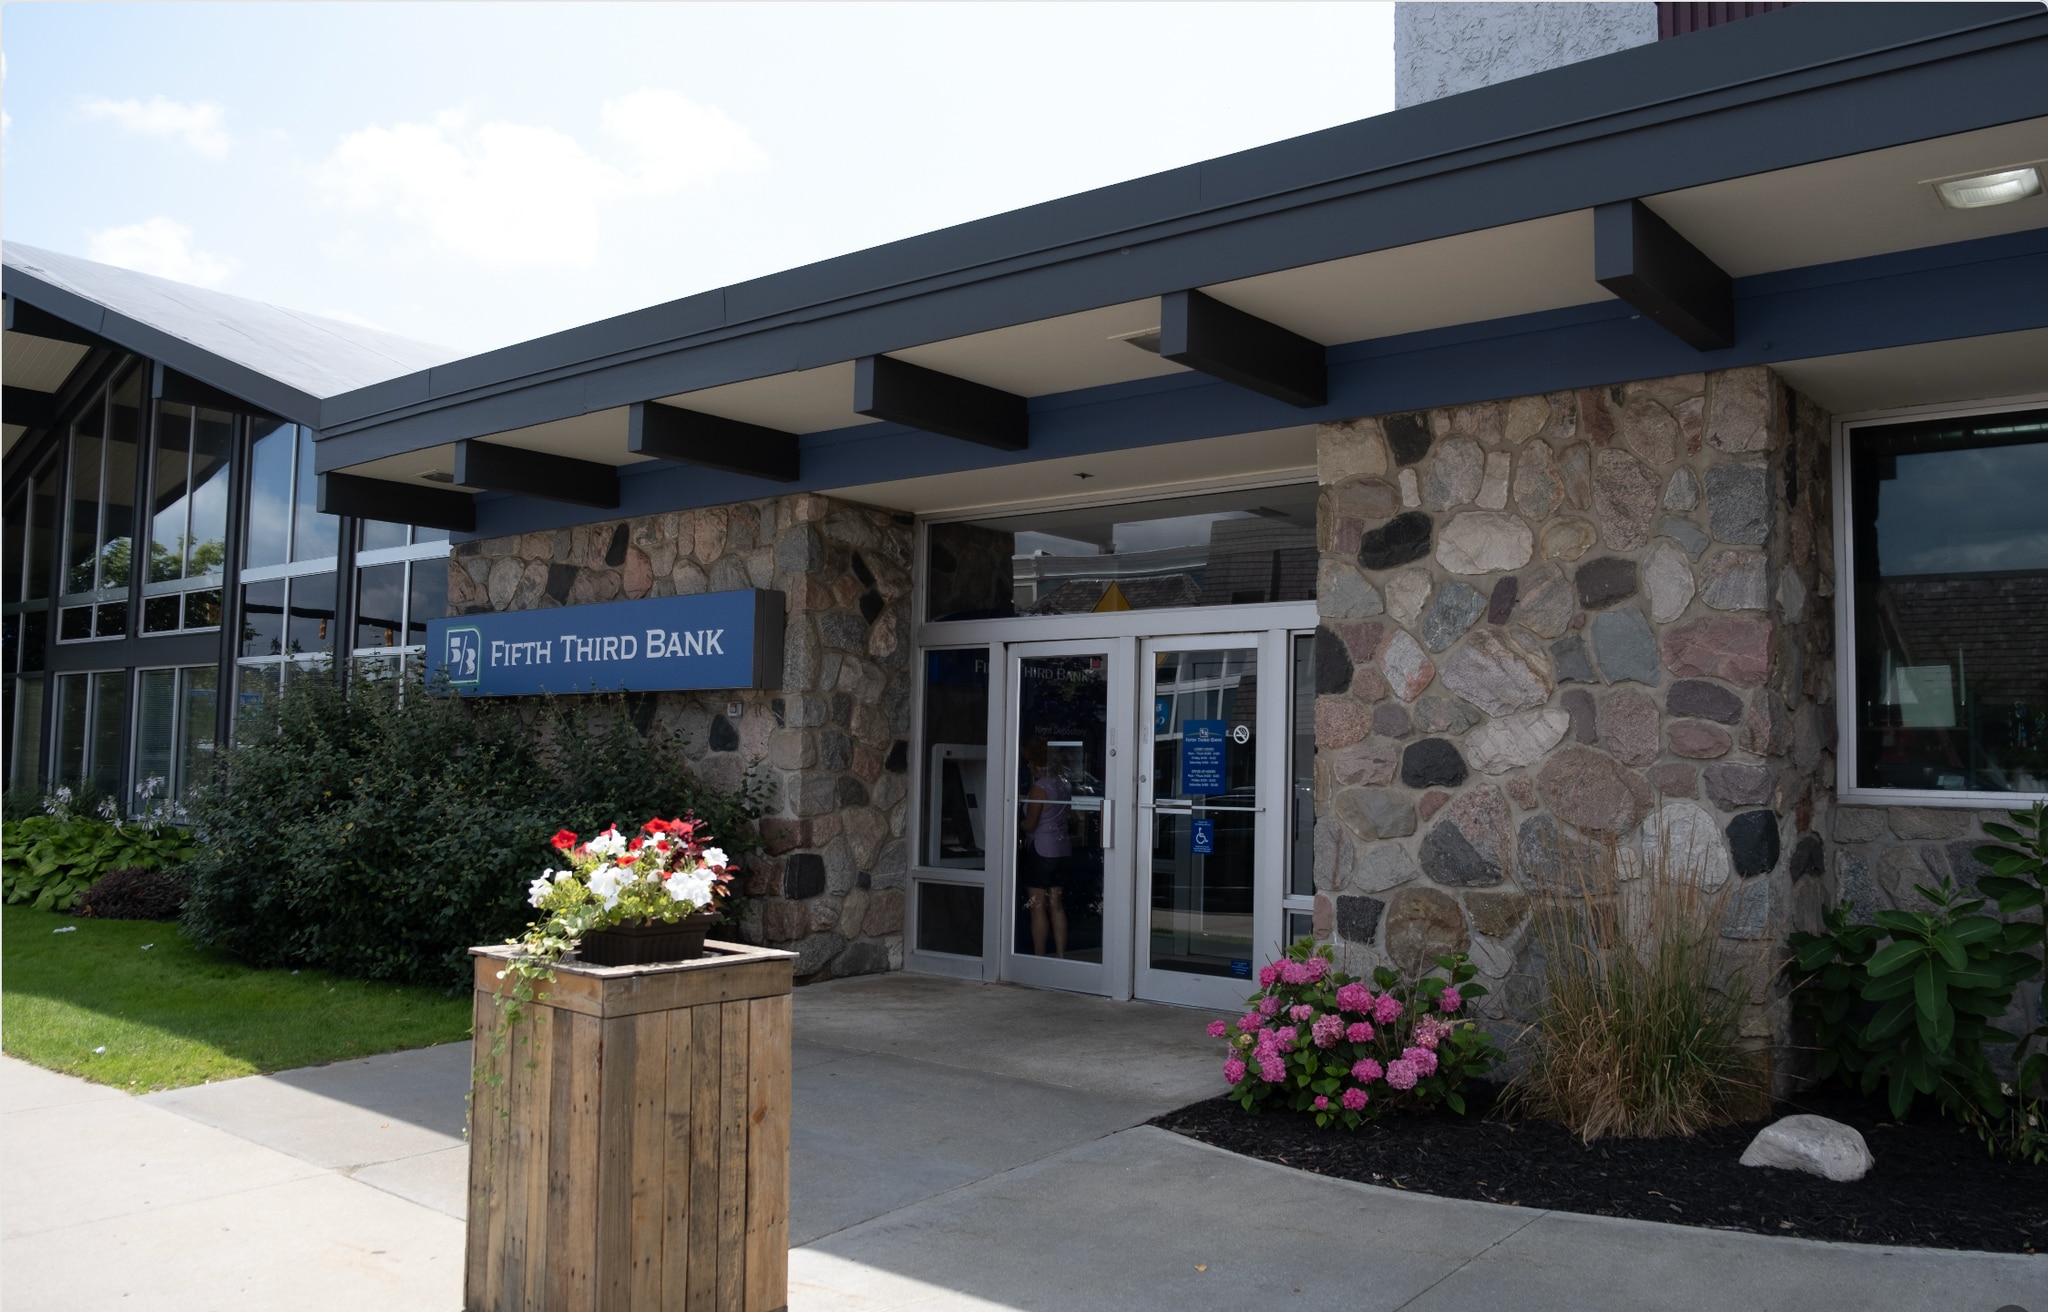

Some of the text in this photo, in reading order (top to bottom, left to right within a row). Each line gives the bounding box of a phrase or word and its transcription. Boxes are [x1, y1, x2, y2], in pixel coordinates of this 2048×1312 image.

[491, 628, 725, 667] FIFTH THIRD BANK
[1022, 666, 1054, 680] HIRD
